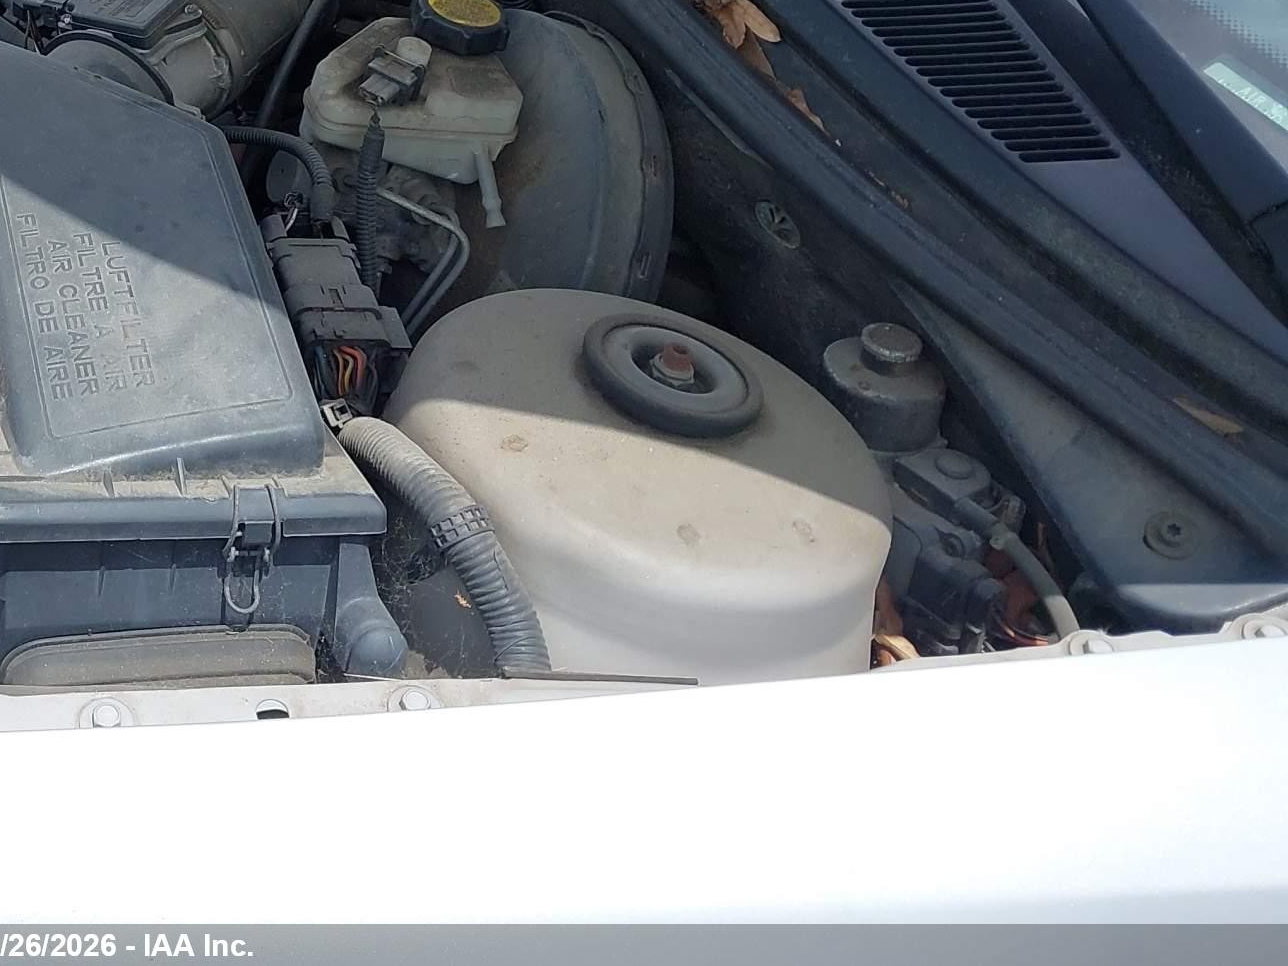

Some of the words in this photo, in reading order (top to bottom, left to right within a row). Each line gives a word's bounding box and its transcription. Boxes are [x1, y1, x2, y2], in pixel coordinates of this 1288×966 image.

[16, 213, 50, 290] FILTRO
[47, 239, 73, 273] AIR
[73, 233, 109, 313] FILTRE
[33, 301, 59, 333] DE
[58, 284, 100, 396] CLEANER
[101, 241, 155, 387] LUFTFILTER
[43, 346, 73, 400] AIRE
